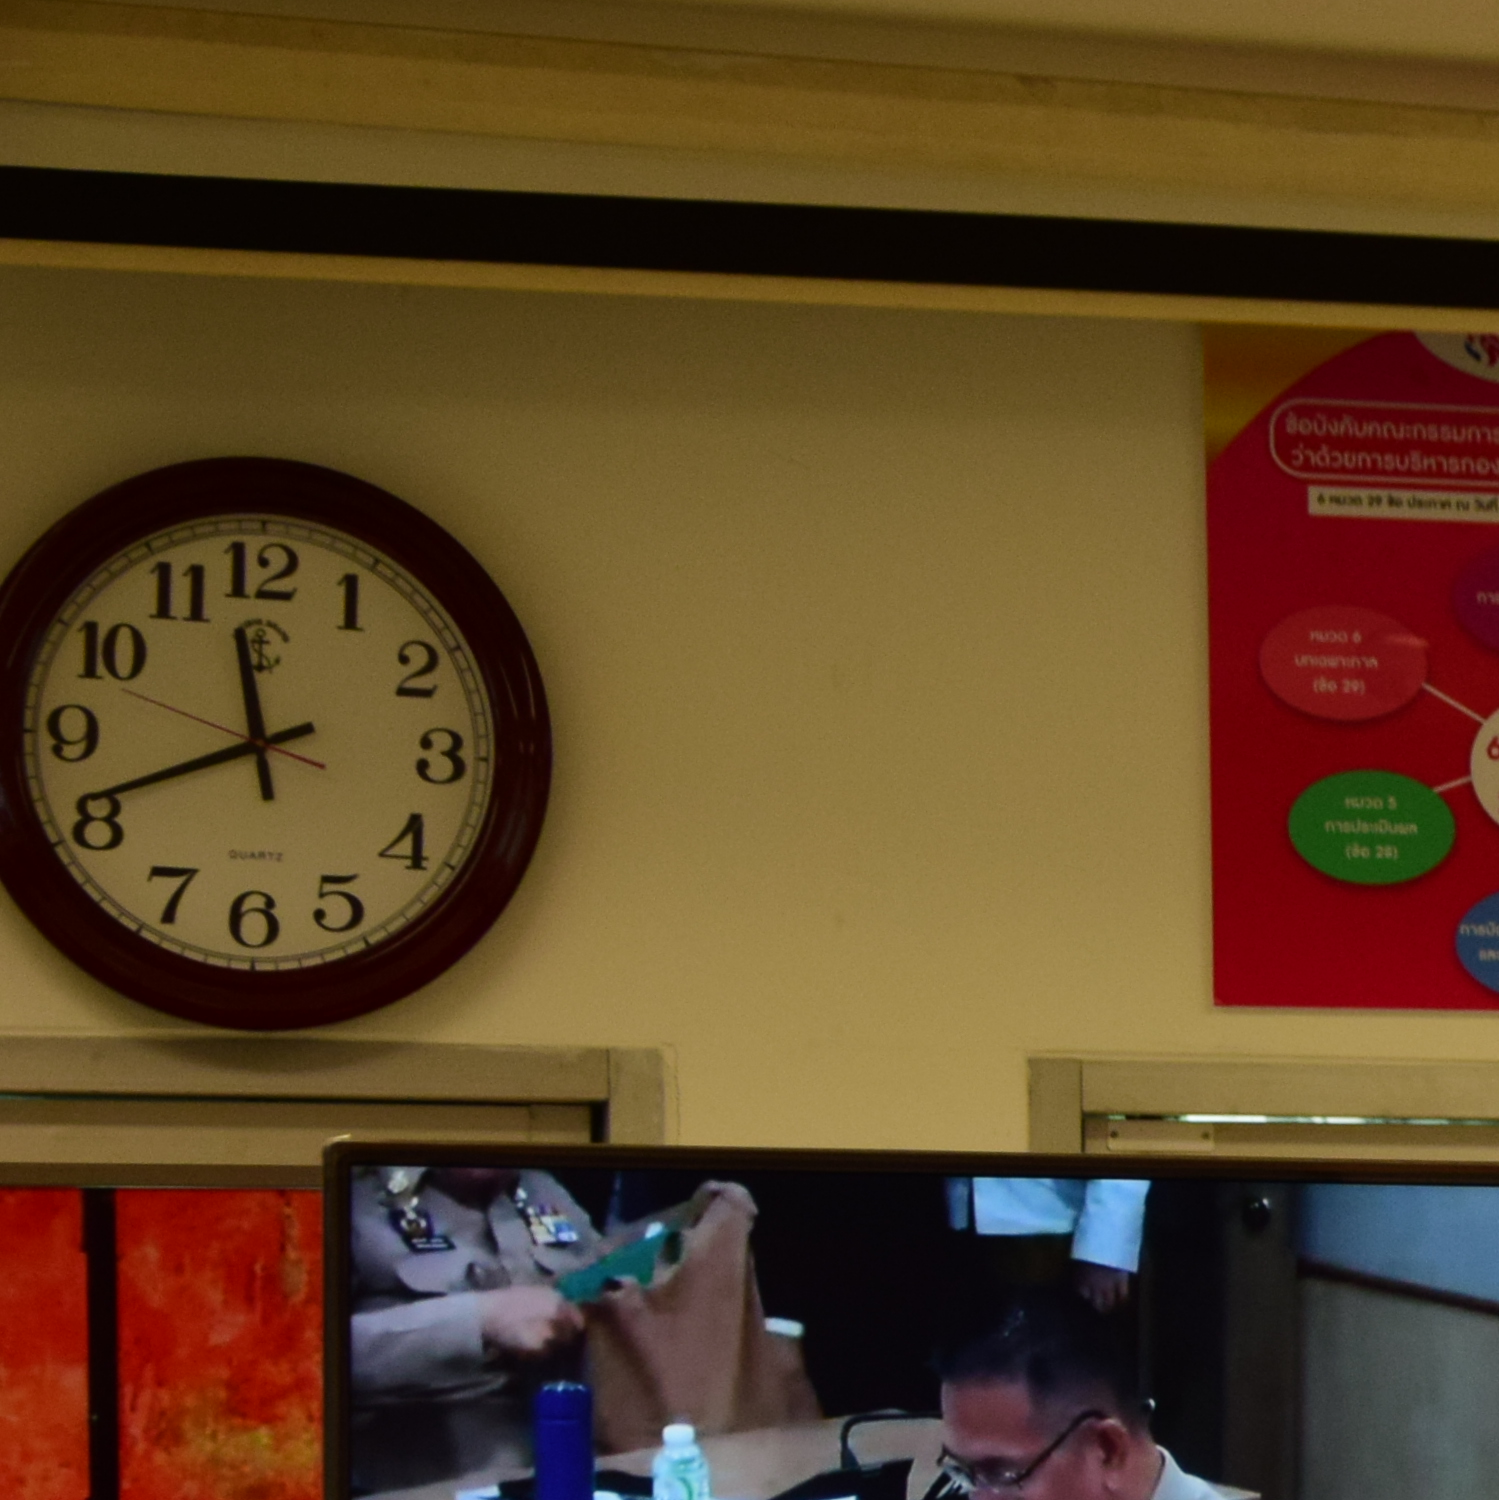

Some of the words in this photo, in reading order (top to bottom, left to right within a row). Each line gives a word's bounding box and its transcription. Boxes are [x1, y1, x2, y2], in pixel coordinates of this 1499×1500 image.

[149, 561, 211, 622] 11
[224, 541, 299, 601] 12
[337, 573, 364, 632] 1
[77, 620, 147, 681] 10
[396, 640, 439, 699] 2
[46, 704, 99, 762] 9
[415, 727, 466, 784] 3
[71, 792, 124, 850] 8
[377, 812, 429, 871] 4
[228, 848, 284, 863] QUARTZ
[147, 865, 200, 925] 7
[227, 890, 280, 949] 6
[312, 873, 364, 932] 5
